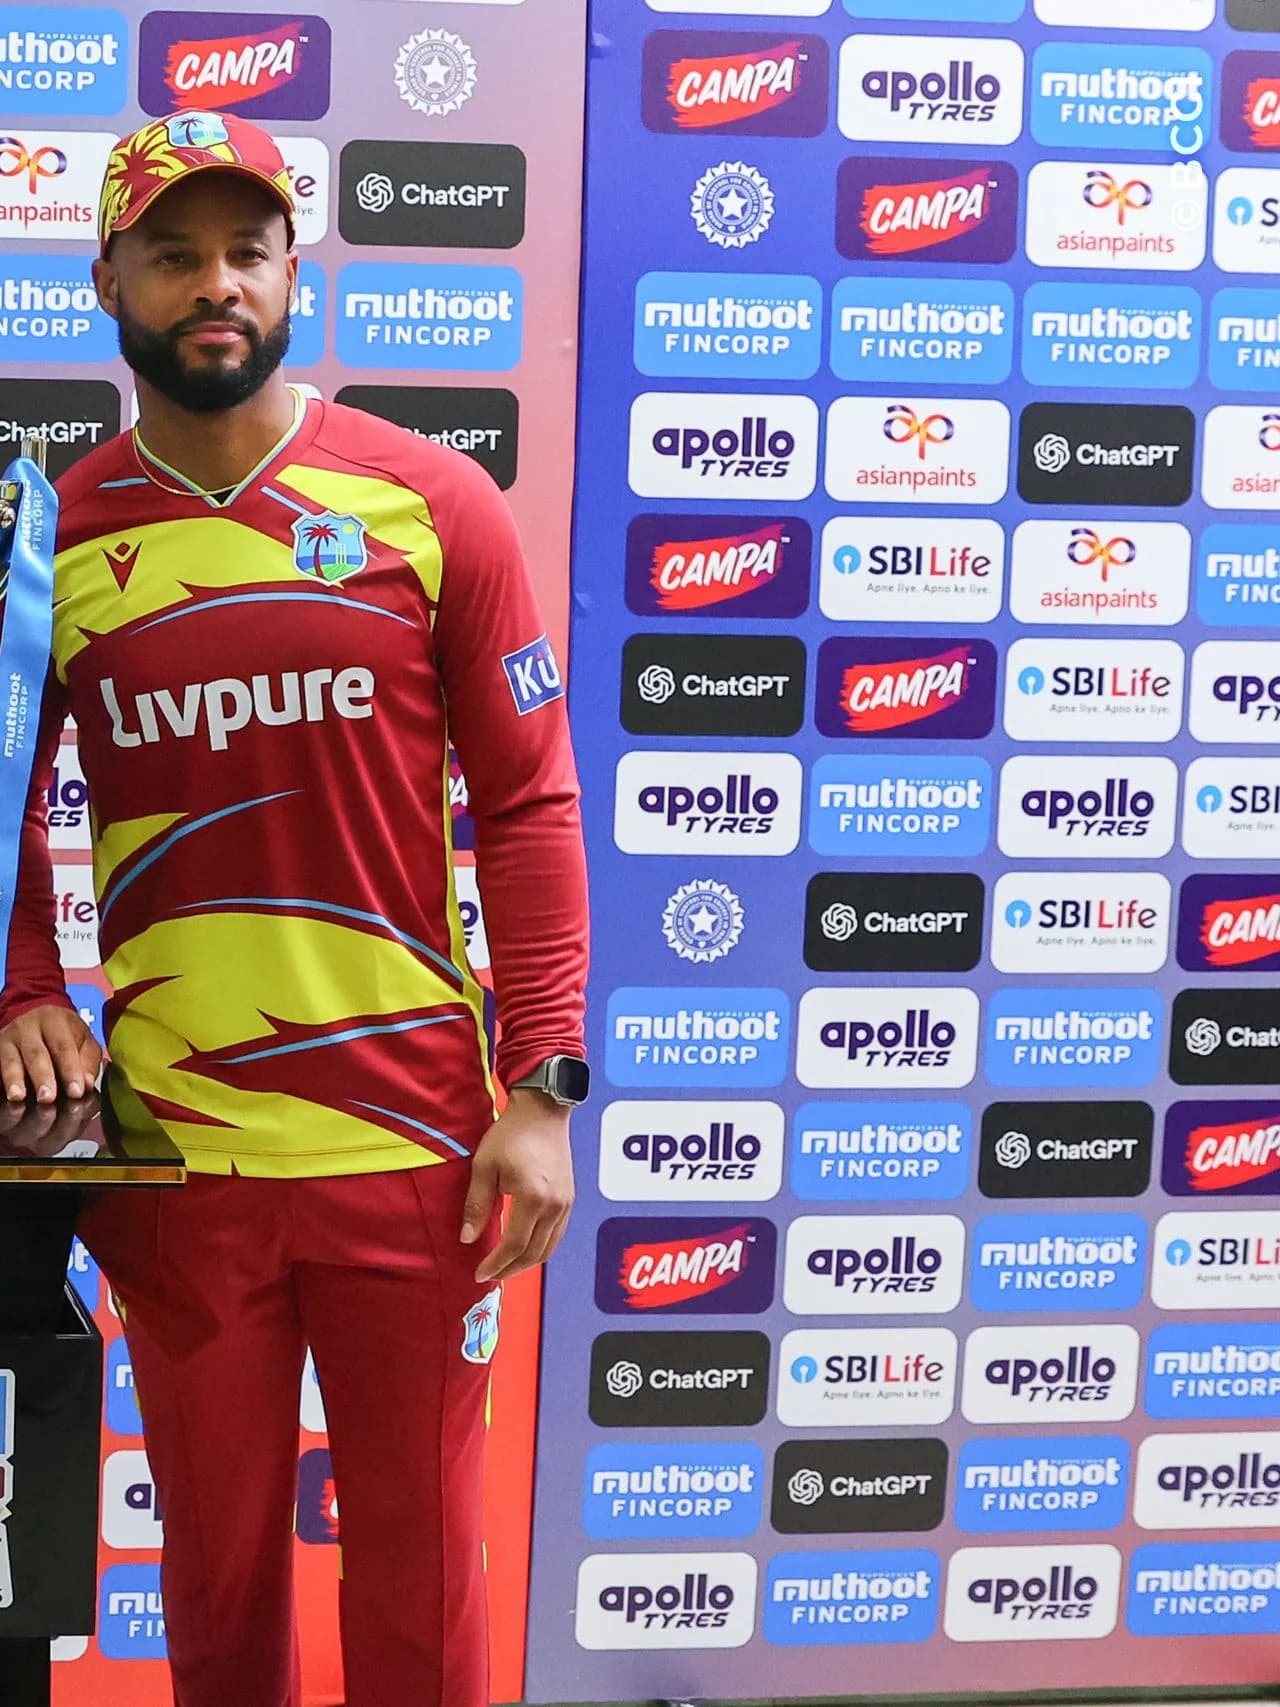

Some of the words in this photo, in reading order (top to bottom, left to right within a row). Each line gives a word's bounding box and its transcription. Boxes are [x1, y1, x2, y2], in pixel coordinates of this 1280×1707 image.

[175, 40, 294, 89] CAMPA
[677, 57, 794, 107] CAMPA
[862, 61, 1000, 111] apollo
[910, 103, 995, 121] TYRES
[402, 184, 509, 206] ChatGPT
[870, 184, 984, 233] CAMPA
[1057, 230, 1174, 257] asianpaints
[346, 289, 513, 321] muthoot
[645, 298, 812, 329] muthoot
[841, 303, 1004, 335] muthoot
[367, 325, 490, 345] FINCORP
[666, 334, 789, 354] FINCORP
[862, 338, 982, 359] FINCORP
[653, 417, 794, 473] apollo
[1077, 444, 1179, 466] ChatGPT
[701, 460, 789, 477] TYRES
[856, 465, 976, 492] asianpaints
[660, 540, 777, 590] CAMPA
[869, 546, 922, 575] SBI
[930, 547, 991, 577] Life
[1041, 588, 1157, 614] asianpaints
[683, 675, 789, 696] ChatGPT
[850, 662, 963, 712] CAMPA
[1052, 667, 1104, 696] SBI
[1112, 668, 1170, 697] Life
[4, 672, 21, 757] muthoot
[16, 685, 28, 749] FINCORP
[101, 666, 375, 752] Livpure
[820, 779, 982, 808] muthoot
[1022, 779, 1154, 831] apollo
[840, 814, 959, 832] FINCORP
[1067, 820, 1149, 836] TYRES
[864, 912, 968, 932] ChatGPT
[1039, 900, 1090, 928] SBI
[1098, 900, 1157, 928] Life
[616, 1011, 779, 1040] muthoot
[821, 1010, 955, 1061] apollo
[996, 1011, 1152, 1040] muthoot
[636, 1046, 757, 1064] FINCORP
[867, 1051, 950, 1066] TYRES
[1015, 1046, 1130, 1064] FINCORP
[623, 1123, 760, 1175] apollo
[802, 1125, 961, 1153] muthoot
[1037, 1140, 1138, 1160] ChatGPT
[670, 1164, 756, 1179] TYRES
[821, 1159, 939, 1177] FINCORP
[629, 1240, 742, 1289] CAMPA
[1199, 1239, 1248, 1265] SBI
[650, 1369, 753, 1388] ChatGPT
[825, 1356, 877, 1383] SBI
[885, 1355, 944, 1382] Life
[986, 1346, 1115, 1396] apollo
[1029, 1386, 1110, 1401] TYRES
[593, 1464, 754, 1493] muthoot
[830, 1476, 931, 1496] ChatGPT
[965, 1458, 1120, 1488] muthoot
[613, 1499, 731, 1516] FINCORP
[983, 1491, 1098, 1510] FINCORP
[968, 1566, 1097, 1616] apollo
[1154, 1595, 1267, 1614] FINCORP
[1012, 1604, 1092, 1619] TYRES
